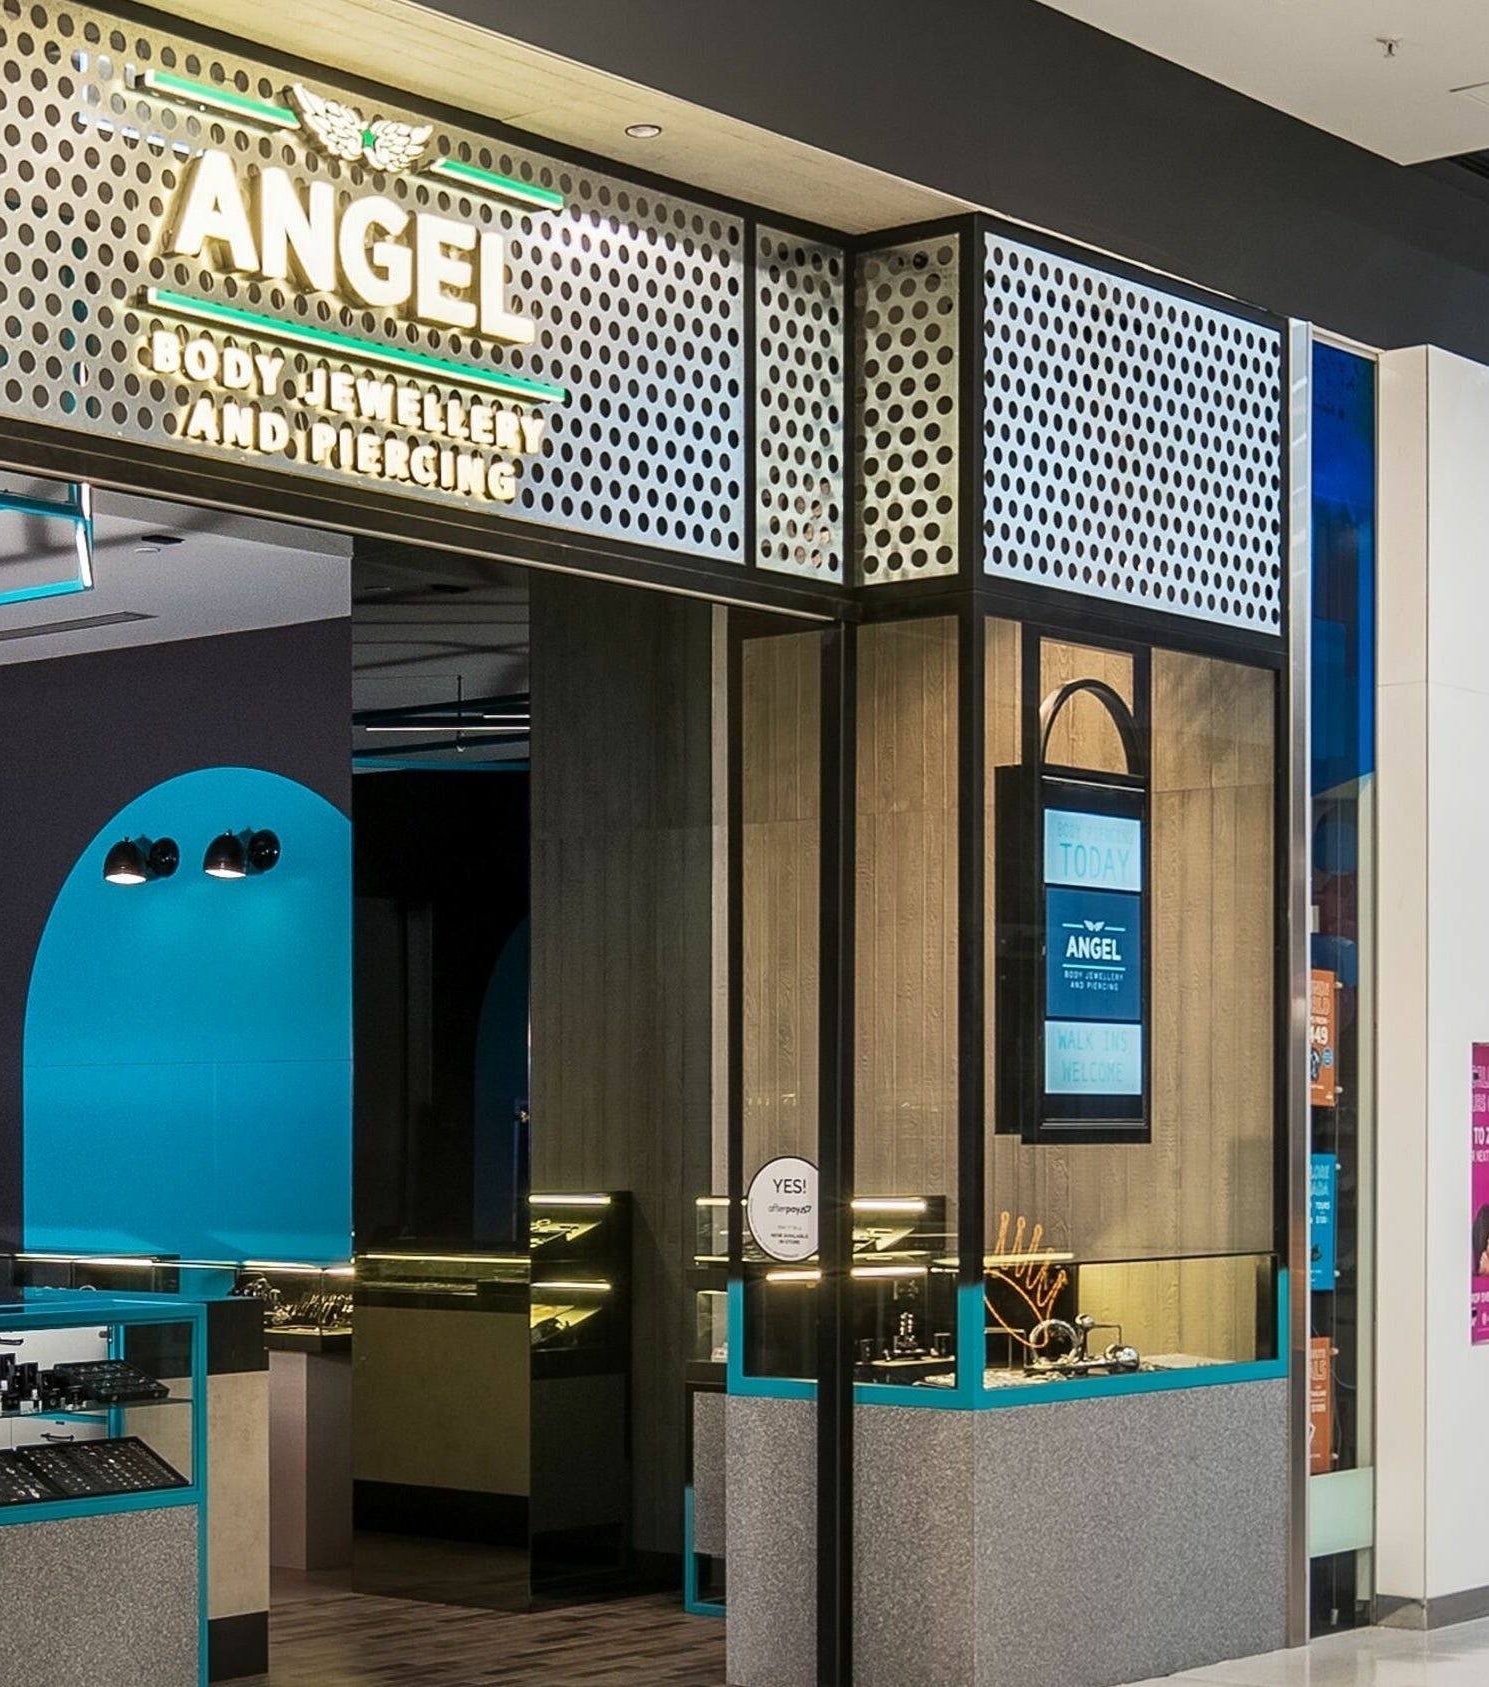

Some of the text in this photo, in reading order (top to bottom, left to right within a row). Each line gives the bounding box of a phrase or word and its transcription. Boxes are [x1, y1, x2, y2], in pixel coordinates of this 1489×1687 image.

[167, 149, 536, 346] ANGEL
[150, 330, 545, 454] BODY JEWELLERY
[183, 397, 518, 502] AND PIERCING
[1059, 842, 1129, 881] TODAY
[1065, 935, 1122, 961] ANGEL
[1064, 970, 1083, 980] BODY
[1070, 981, 1085, 990] AND
[1057, 1029, 1093, 1050] WALK
[1061, 1060, 1124, 1083] WELCOME
[773, 1178, 807, 1194] YES!
